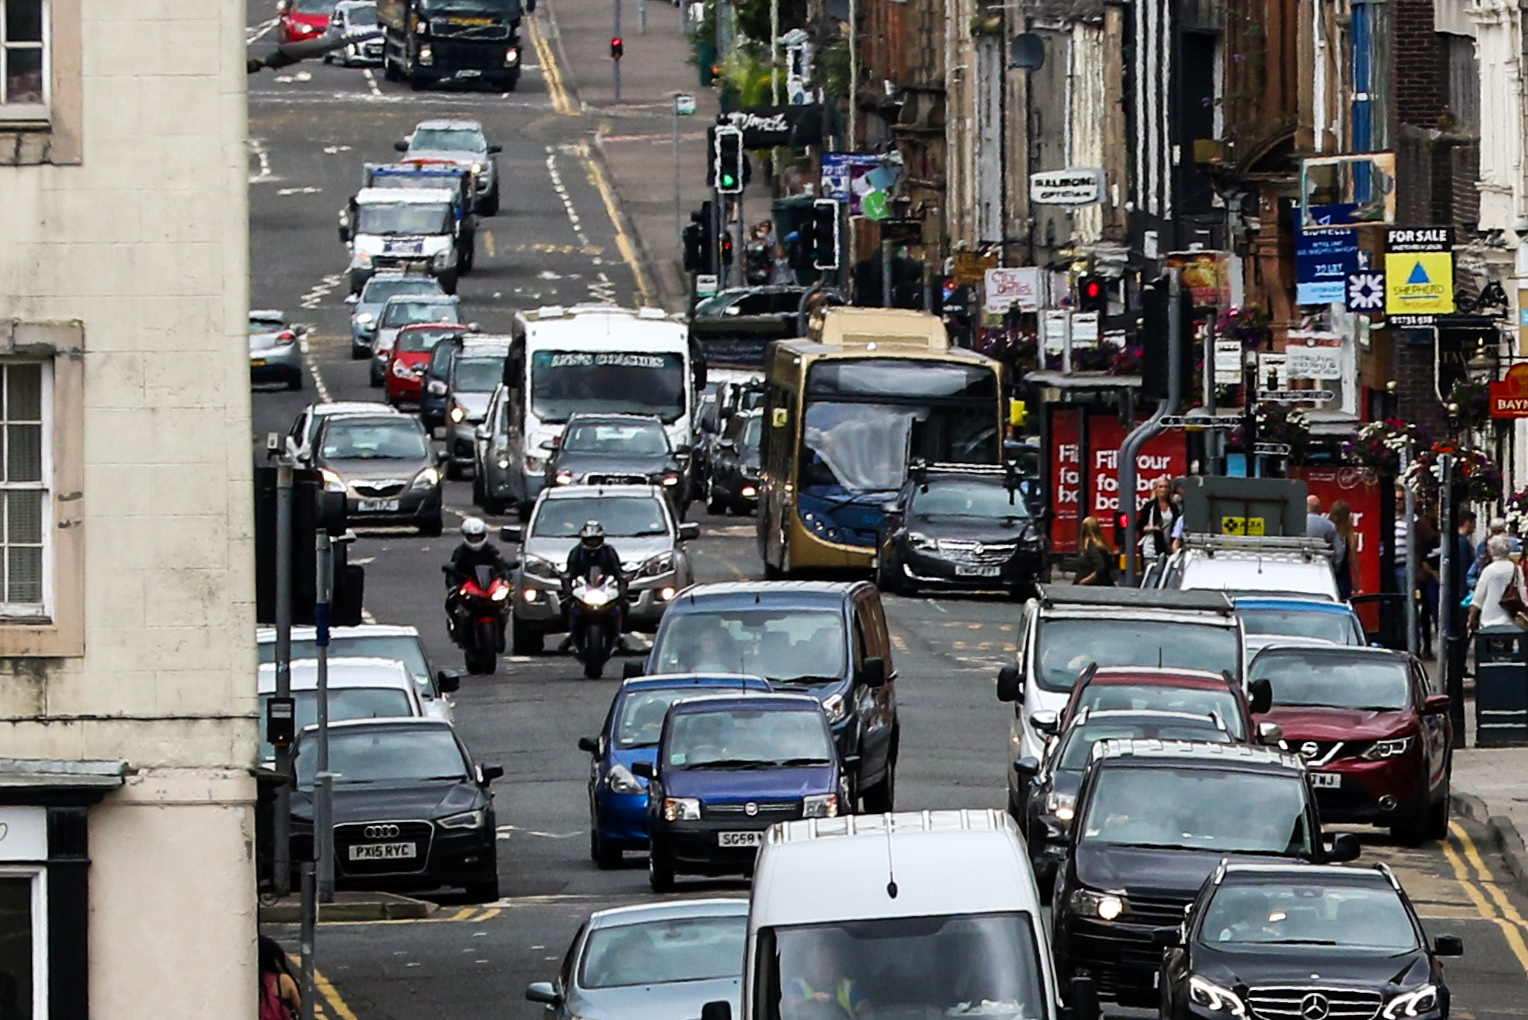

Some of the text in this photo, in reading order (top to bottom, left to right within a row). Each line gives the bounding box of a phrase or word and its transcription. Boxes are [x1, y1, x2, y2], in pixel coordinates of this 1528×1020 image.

[1388, 229, 1447, 243] FOR SALE
[356, 844, 409, 858] PX15 RYC
